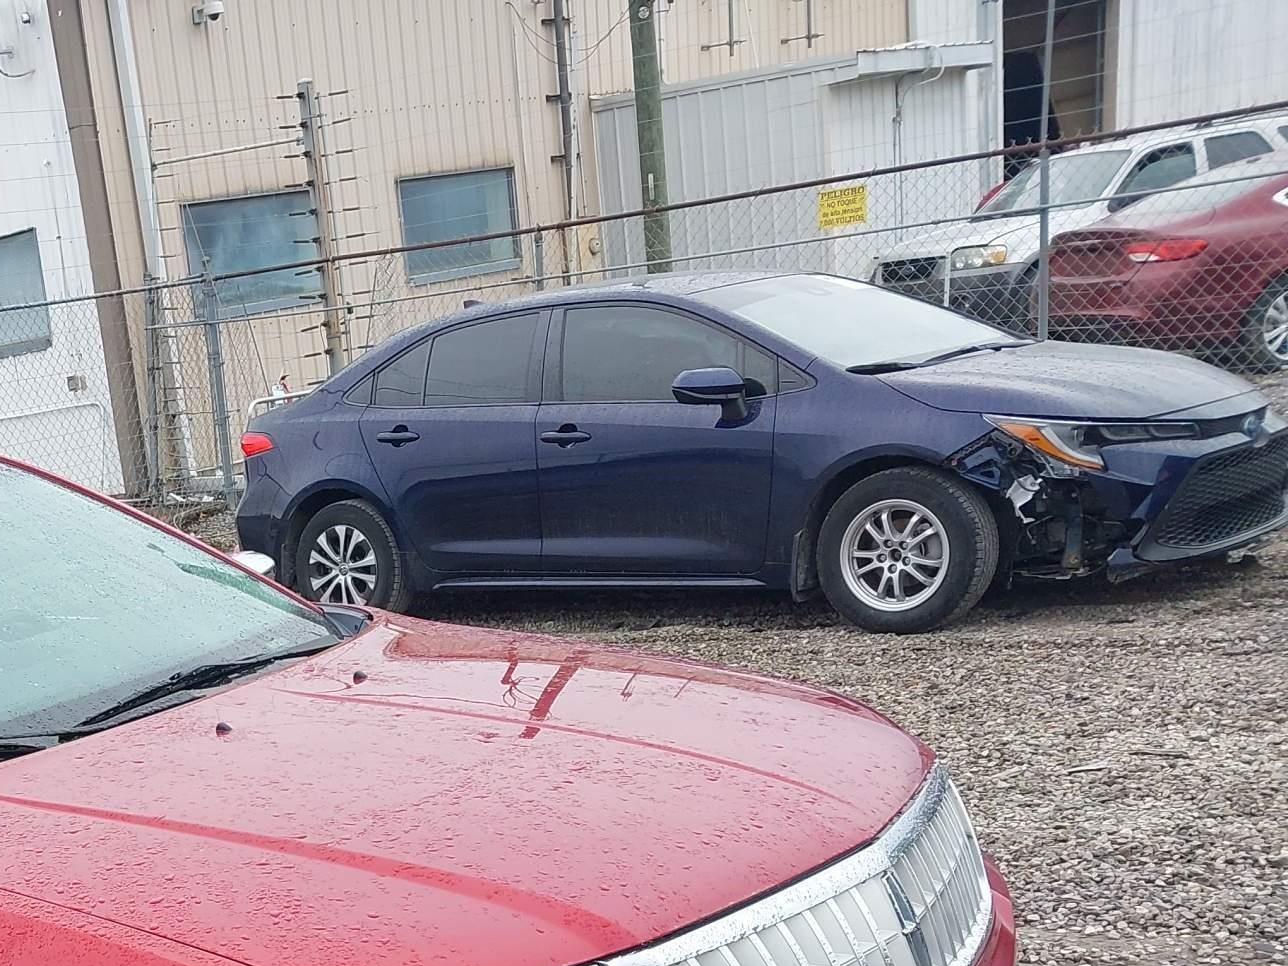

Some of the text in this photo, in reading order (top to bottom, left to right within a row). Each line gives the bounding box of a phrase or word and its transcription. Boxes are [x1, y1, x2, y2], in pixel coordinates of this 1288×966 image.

[820, 186, 865, 200] PELIGRO
[826, 197, 858, 209] NO TOQUE
